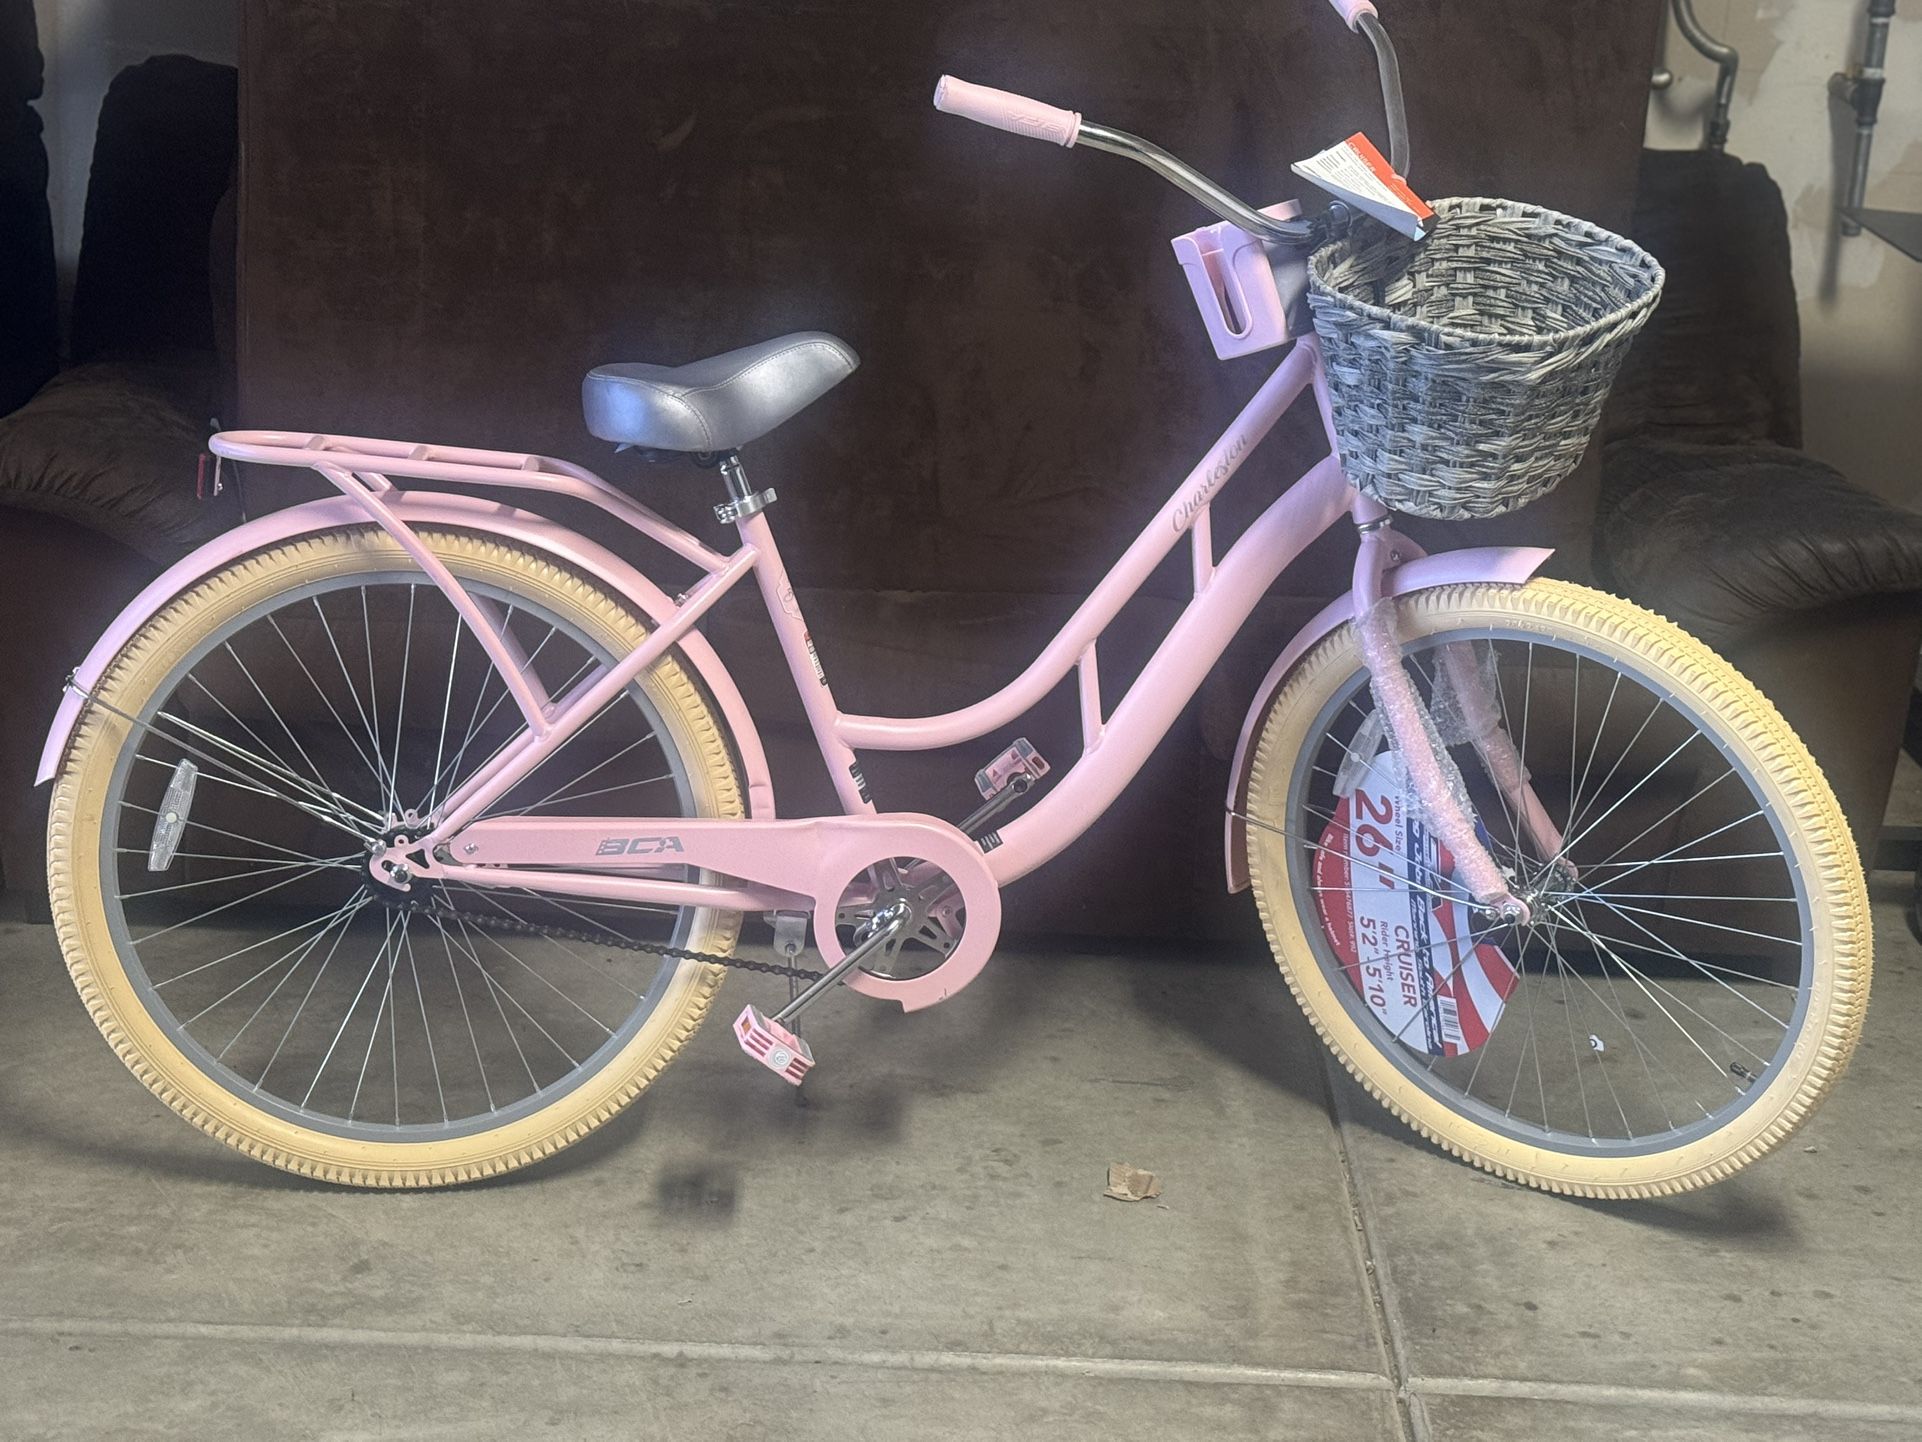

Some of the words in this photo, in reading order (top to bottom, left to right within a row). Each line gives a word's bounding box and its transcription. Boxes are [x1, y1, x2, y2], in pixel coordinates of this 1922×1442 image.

[1173, 435, 1248, 533] Charleston
[595, 836, 684, 856] BCA
[1394, 830, 1403, 852] Size
[1380, 921, 1390, 947] Rider
[1383, 950, 1394, 982] Height
[1394, 925, 1418, 1007] CRUISER
